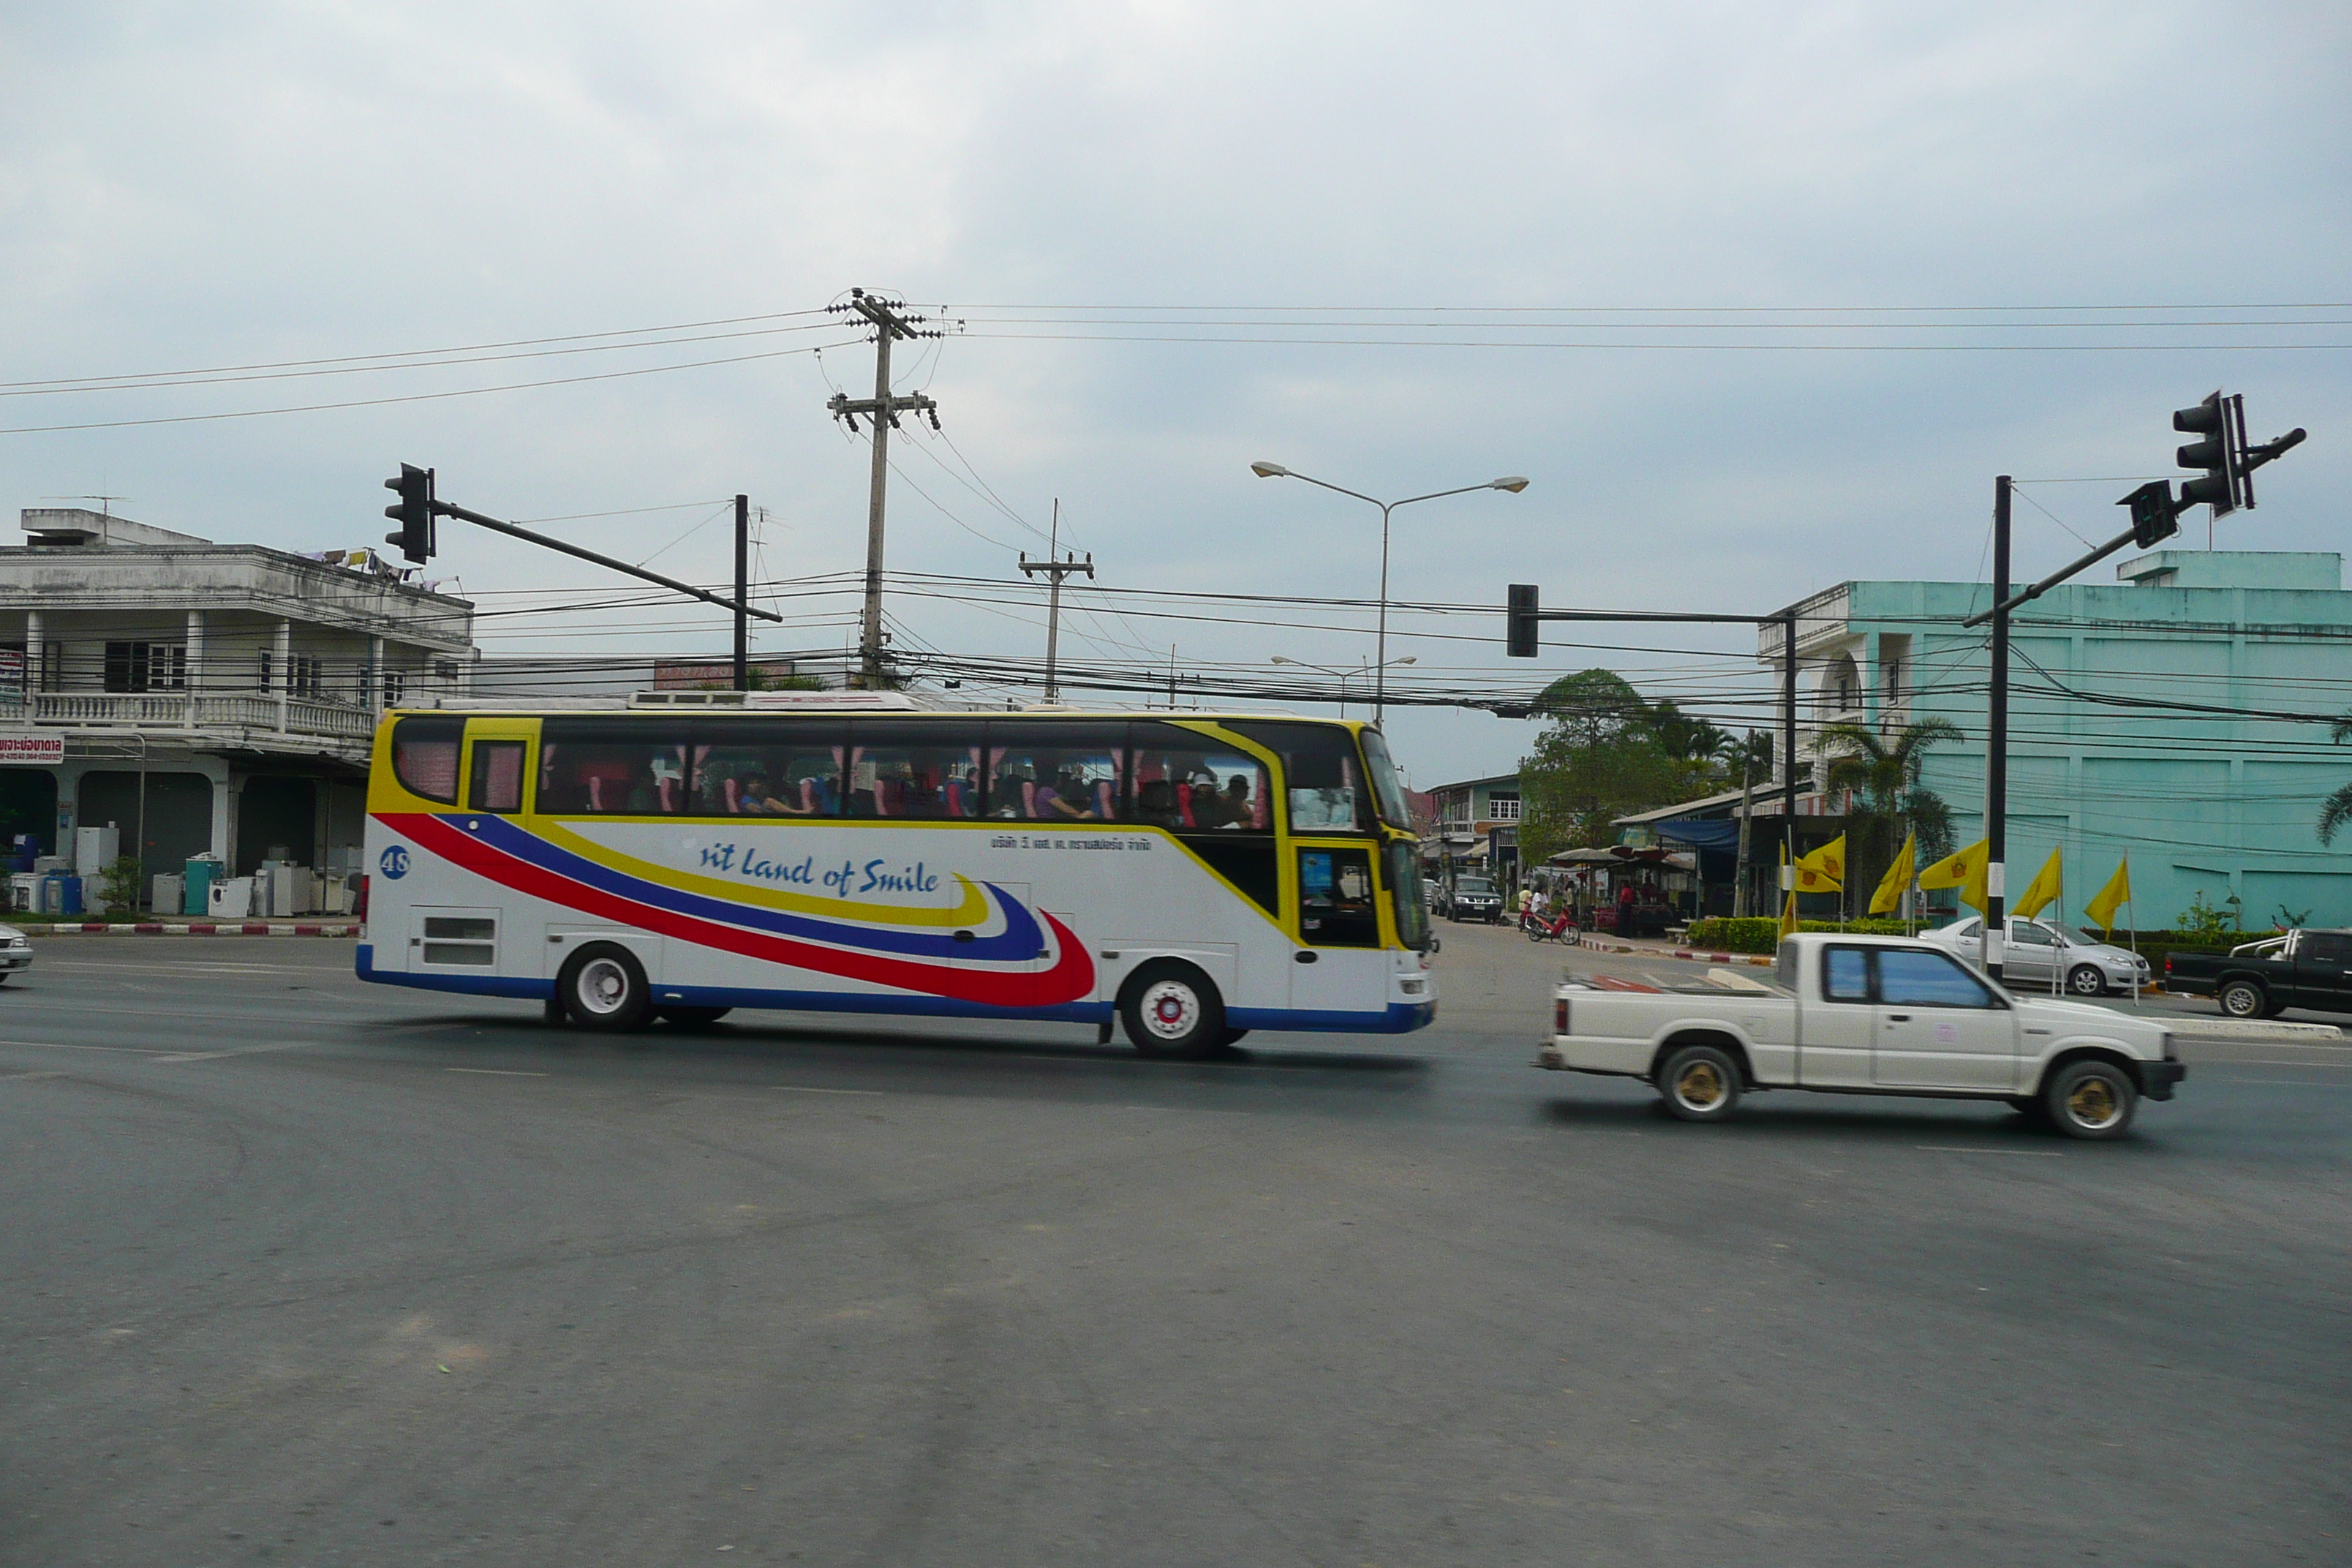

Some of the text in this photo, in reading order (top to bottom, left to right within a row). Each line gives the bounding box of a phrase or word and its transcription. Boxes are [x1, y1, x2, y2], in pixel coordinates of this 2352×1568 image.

[0, 736, 61, 751] บเจาะบ่อบาดาล
[381, 851, 410, 872] 48
[823, 860, 855, 898] of
[859, 859, 940, 893] Smile
